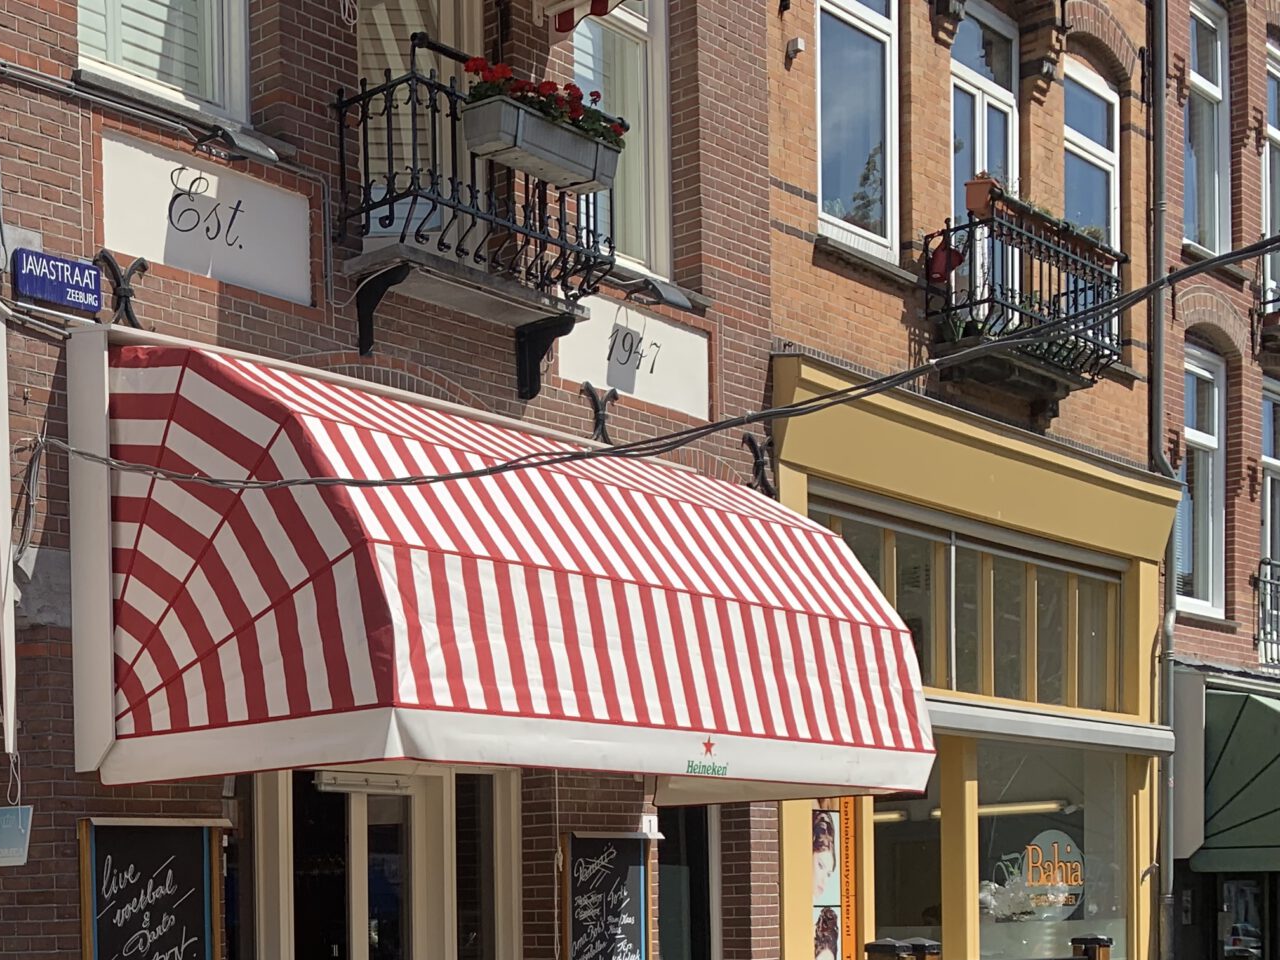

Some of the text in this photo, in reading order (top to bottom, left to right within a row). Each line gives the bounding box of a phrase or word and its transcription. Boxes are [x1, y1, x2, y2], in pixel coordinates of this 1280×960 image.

[168, 166, 245, 250] Est.
[21, 253, 98, 290] JAVASTRAAT
[66, 288, 99, 307] ZEEBURG
[607, 328, 662, 374] 1947
[686, 759, 728, 776] Heineken
[1025, 841, 1084, 887] Bahia
[112, 868, 178, 928] voetbal
[122, 911, 176, 957] Darts
